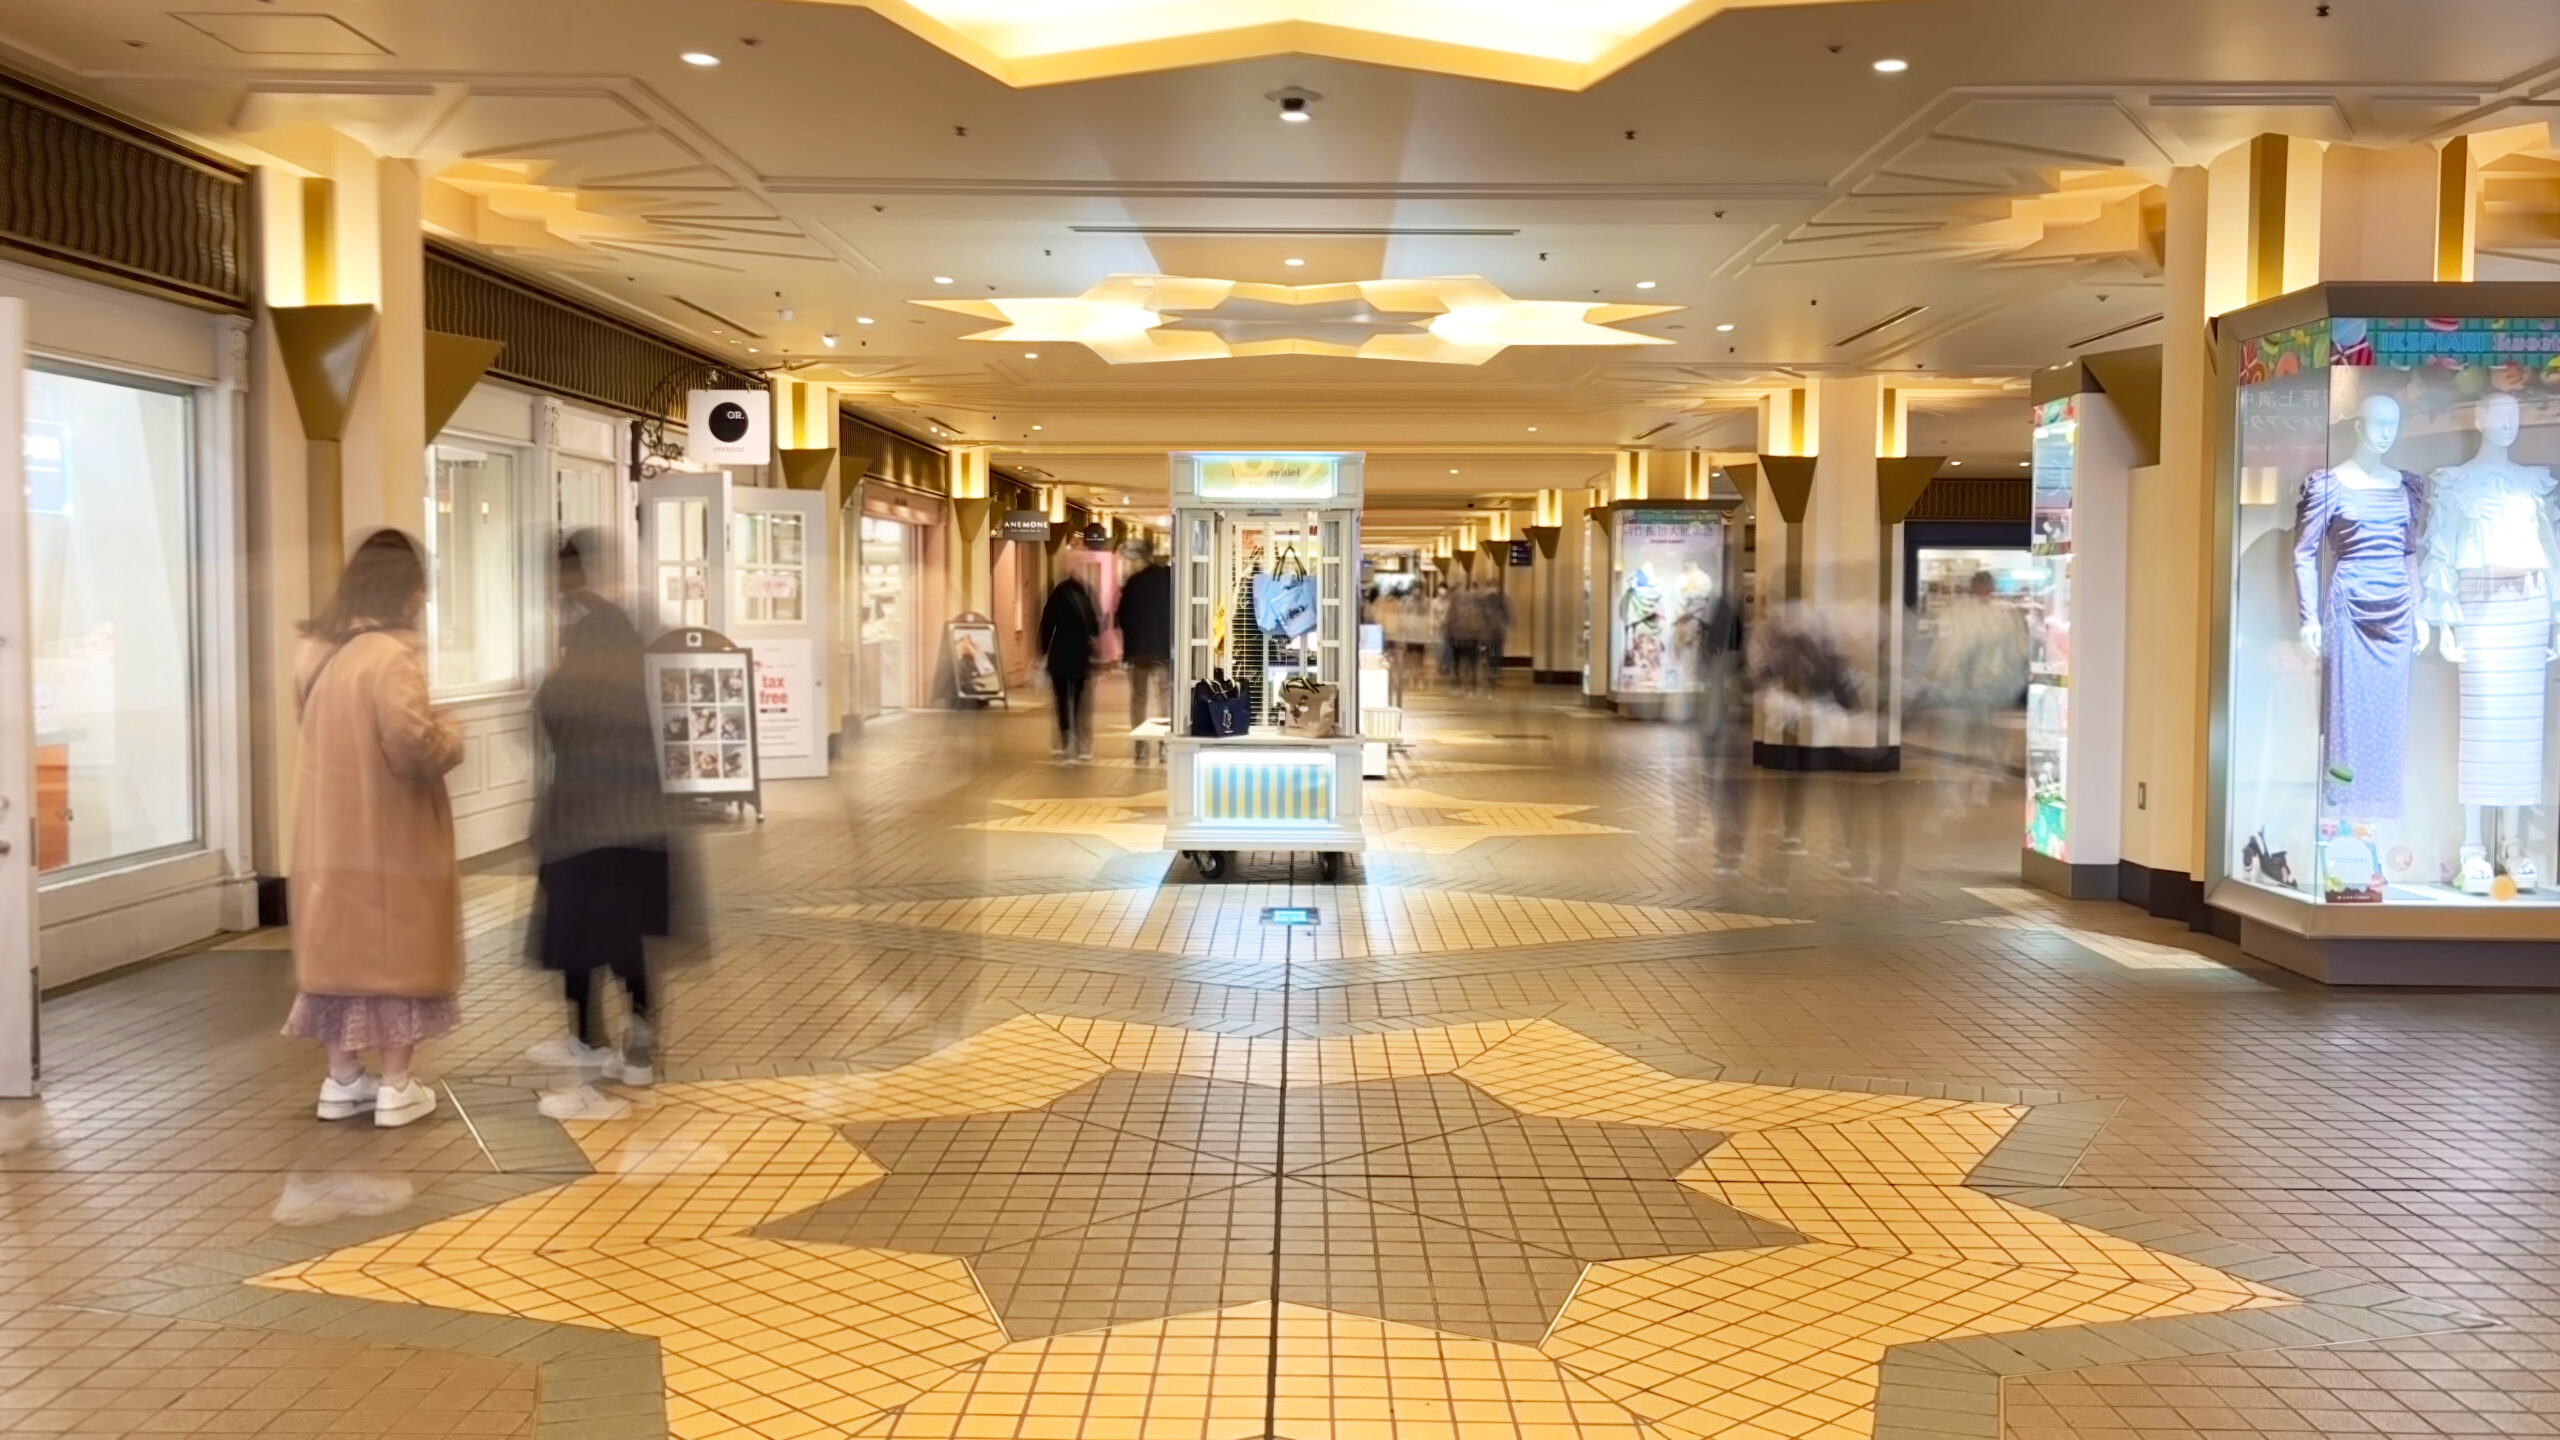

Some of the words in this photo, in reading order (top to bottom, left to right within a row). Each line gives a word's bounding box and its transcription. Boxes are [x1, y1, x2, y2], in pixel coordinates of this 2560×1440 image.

[2382, 332, 2486, 352] IKSPIARI
[727, 411, 745, 420] OR.
[1004, 521, 1048, 529] ANEMONE
[762, 675, 785, 688] tax
[760, 690, 788, 704] free
